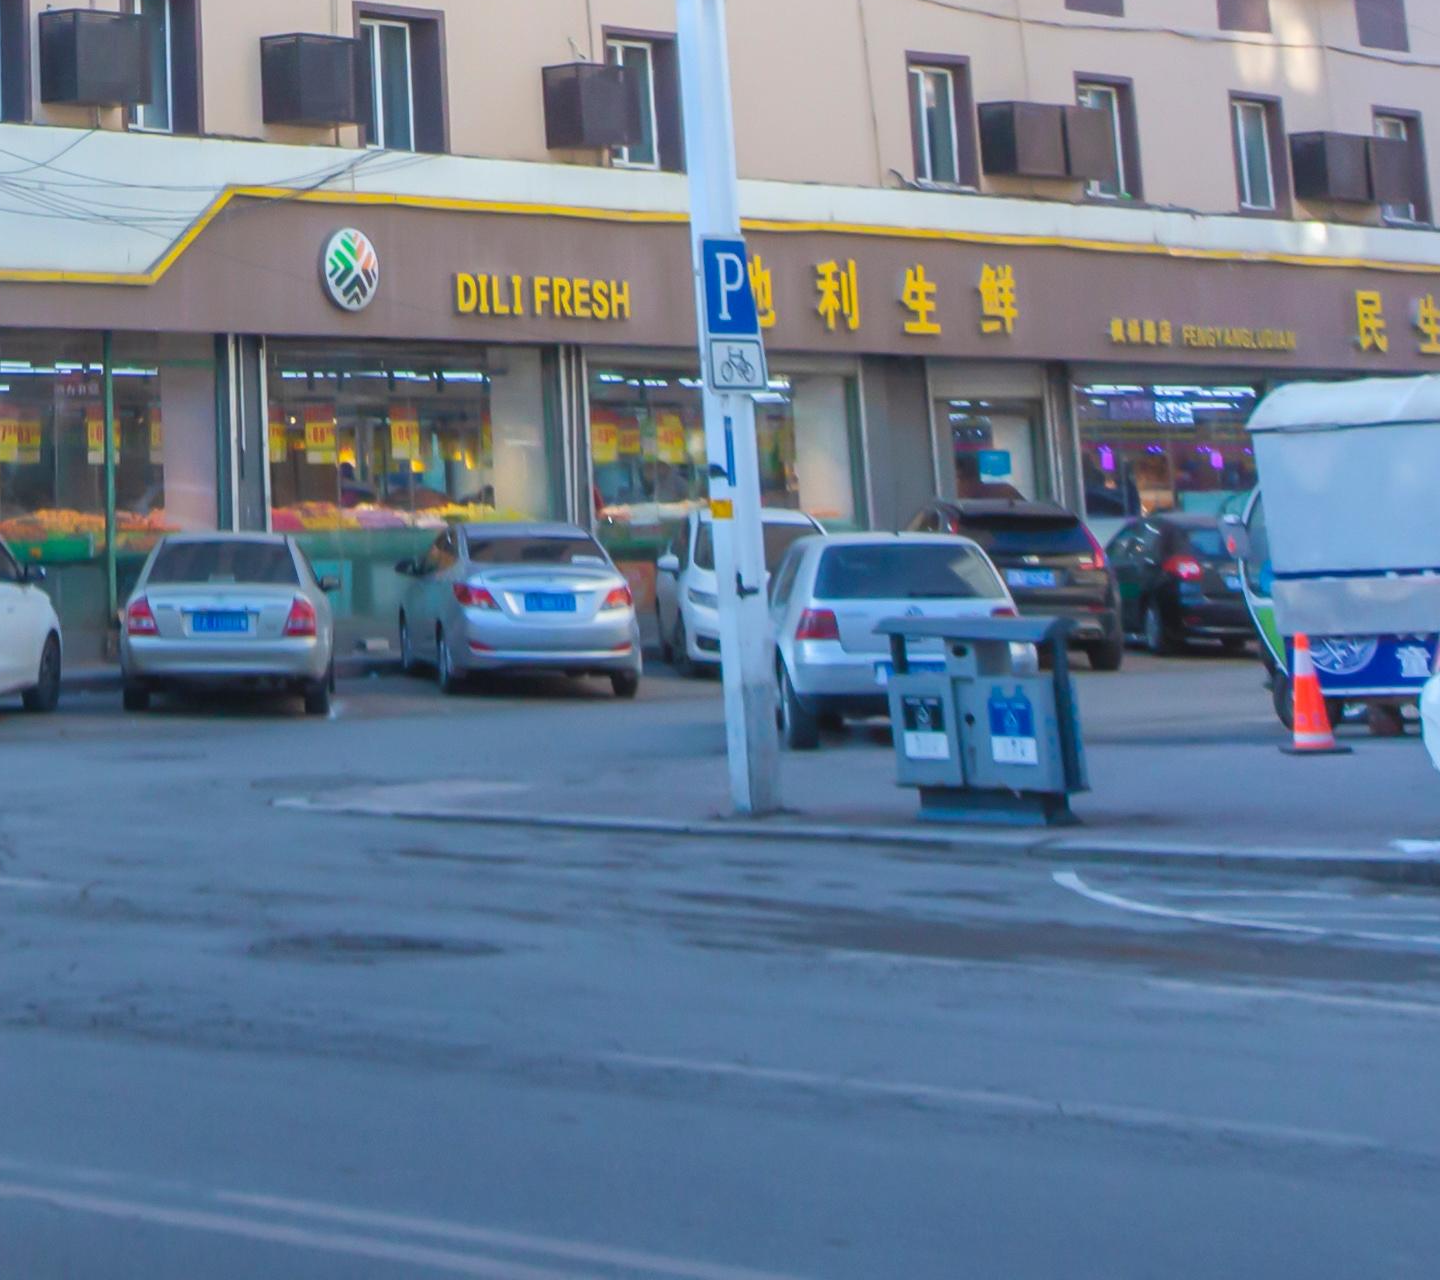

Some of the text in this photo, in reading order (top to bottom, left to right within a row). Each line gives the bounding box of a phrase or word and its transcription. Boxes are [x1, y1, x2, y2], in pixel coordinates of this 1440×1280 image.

[456, 272, 632, 320] DILI FRESH
[714, 251, 745, 322] P
